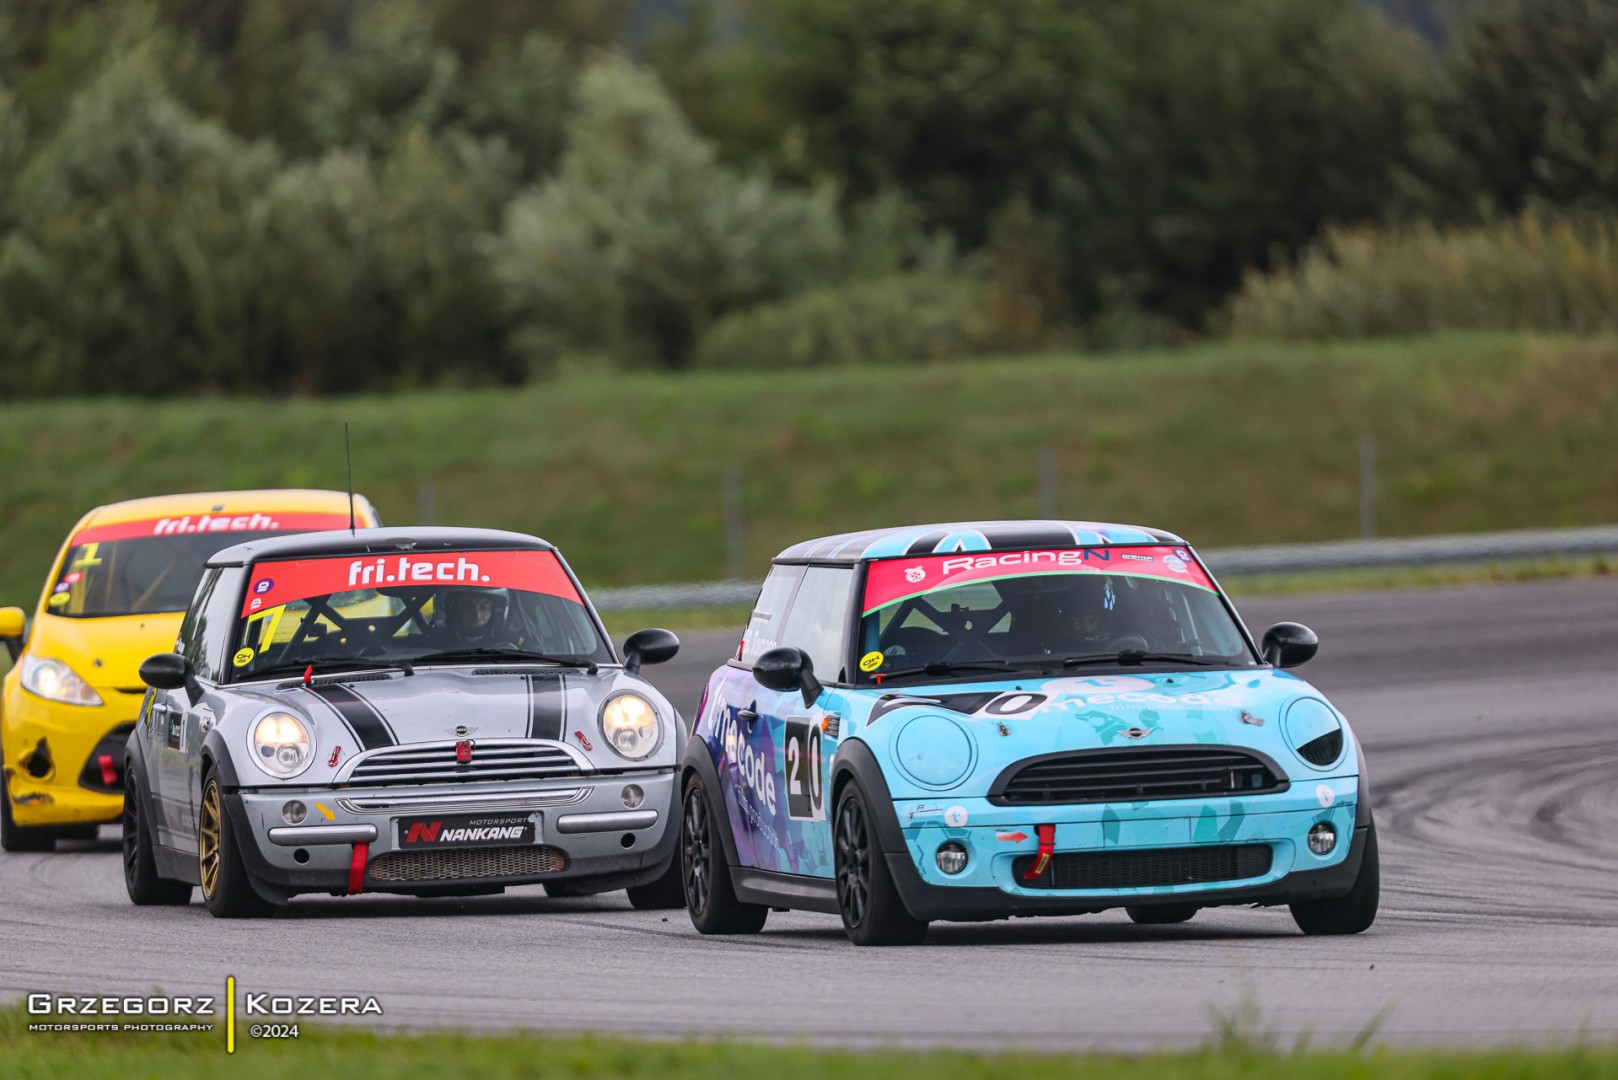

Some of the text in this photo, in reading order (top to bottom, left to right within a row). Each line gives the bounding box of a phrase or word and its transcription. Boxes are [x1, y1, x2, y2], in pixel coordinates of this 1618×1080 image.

[153, 512, 280, 536] fri.tech.
[73, 542, 103, 567] 1
[348, 556, 491, 587] fri.tech.
[788, 723, 823, 811] 20
[468, 816, 528, 826] MOTORSPORT
[439, 825, 524, 842] NANKANG
